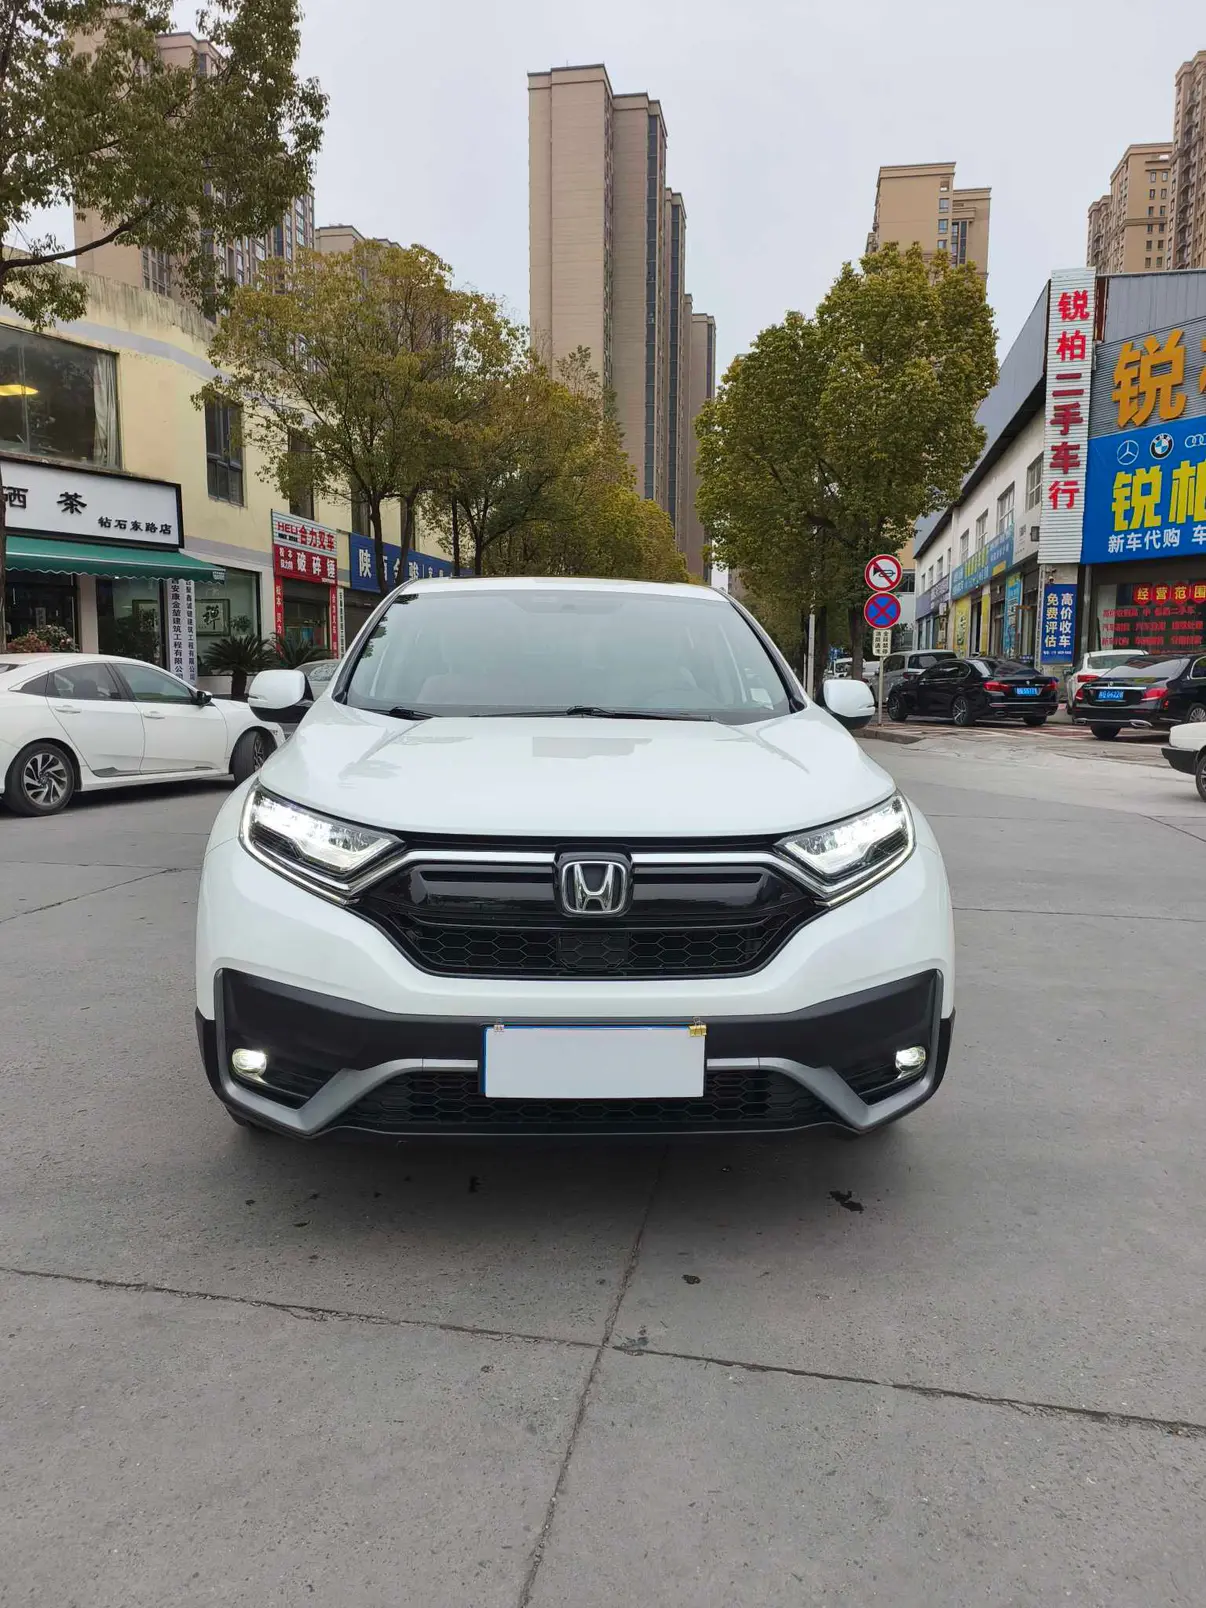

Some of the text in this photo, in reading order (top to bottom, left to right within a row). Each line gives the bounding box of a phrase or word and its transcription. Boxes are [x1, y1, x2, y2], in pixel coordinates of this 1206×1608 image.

[1048, 289, 1090, 509] 锐柏二手车行
[1111, 328, 1206, 428] 锐
[298, 525, 335, 551] 合力叉车
[1108, 528, 1181, 553] 新车代购
[1045, 593, 1059, 648] 免费评估
[1058, 592, 1074, 648] 高价收车
[1137, 585, 1206, 601] 经营范围
